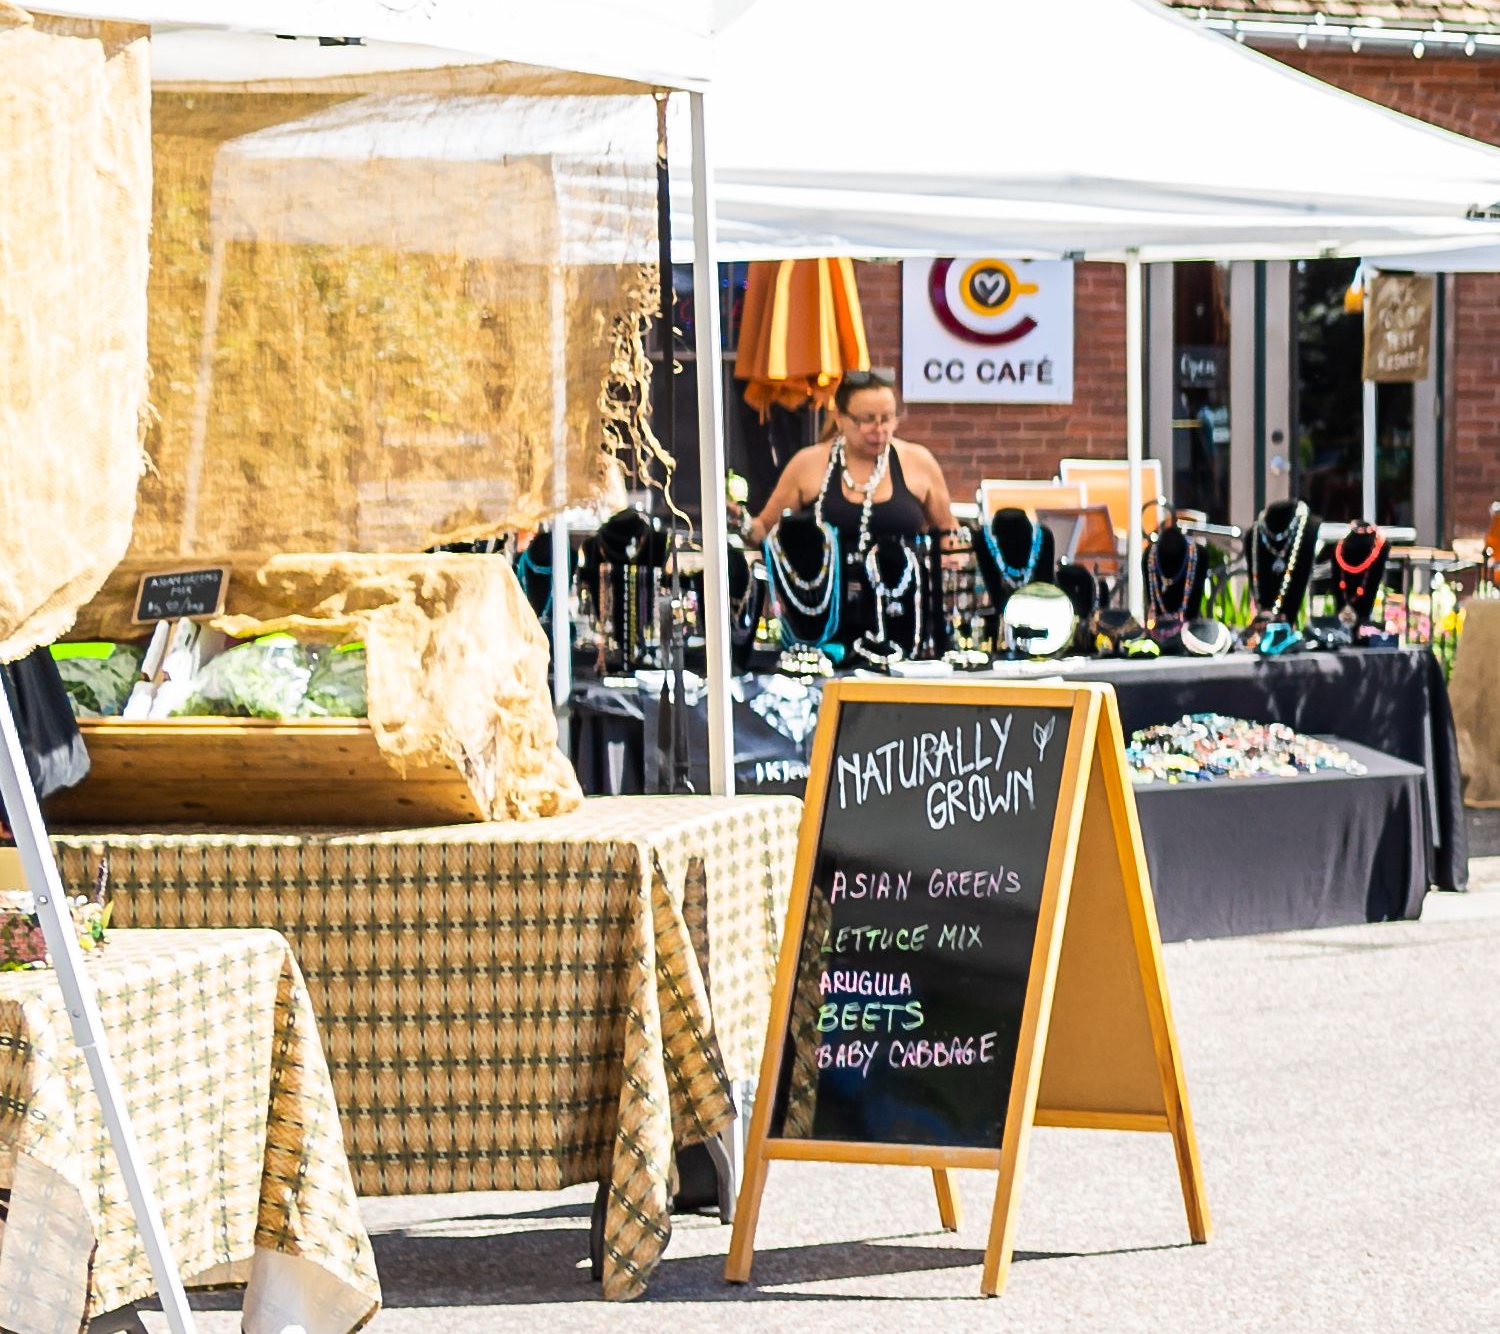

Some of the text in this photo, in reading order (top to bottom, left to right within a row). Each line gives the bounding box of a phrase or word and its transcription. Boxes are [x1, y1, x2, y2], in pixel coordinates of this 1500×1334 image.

[923, 354, 1053, 385] CC CAFÉ
[837, 712, 1013, 810] NATURALLY
[926, 766, 1036, 830] GROWN
[830, 865, 1021, 905] ASIAN GREENS
[820, 923, 983, 954] LETTUCE MIX
[819, 970, 912, 997] ARUGULA
[816, 1000, 925, 1034] BEETS
[815, 1030, 998, 1079] BABY CABBAGE
